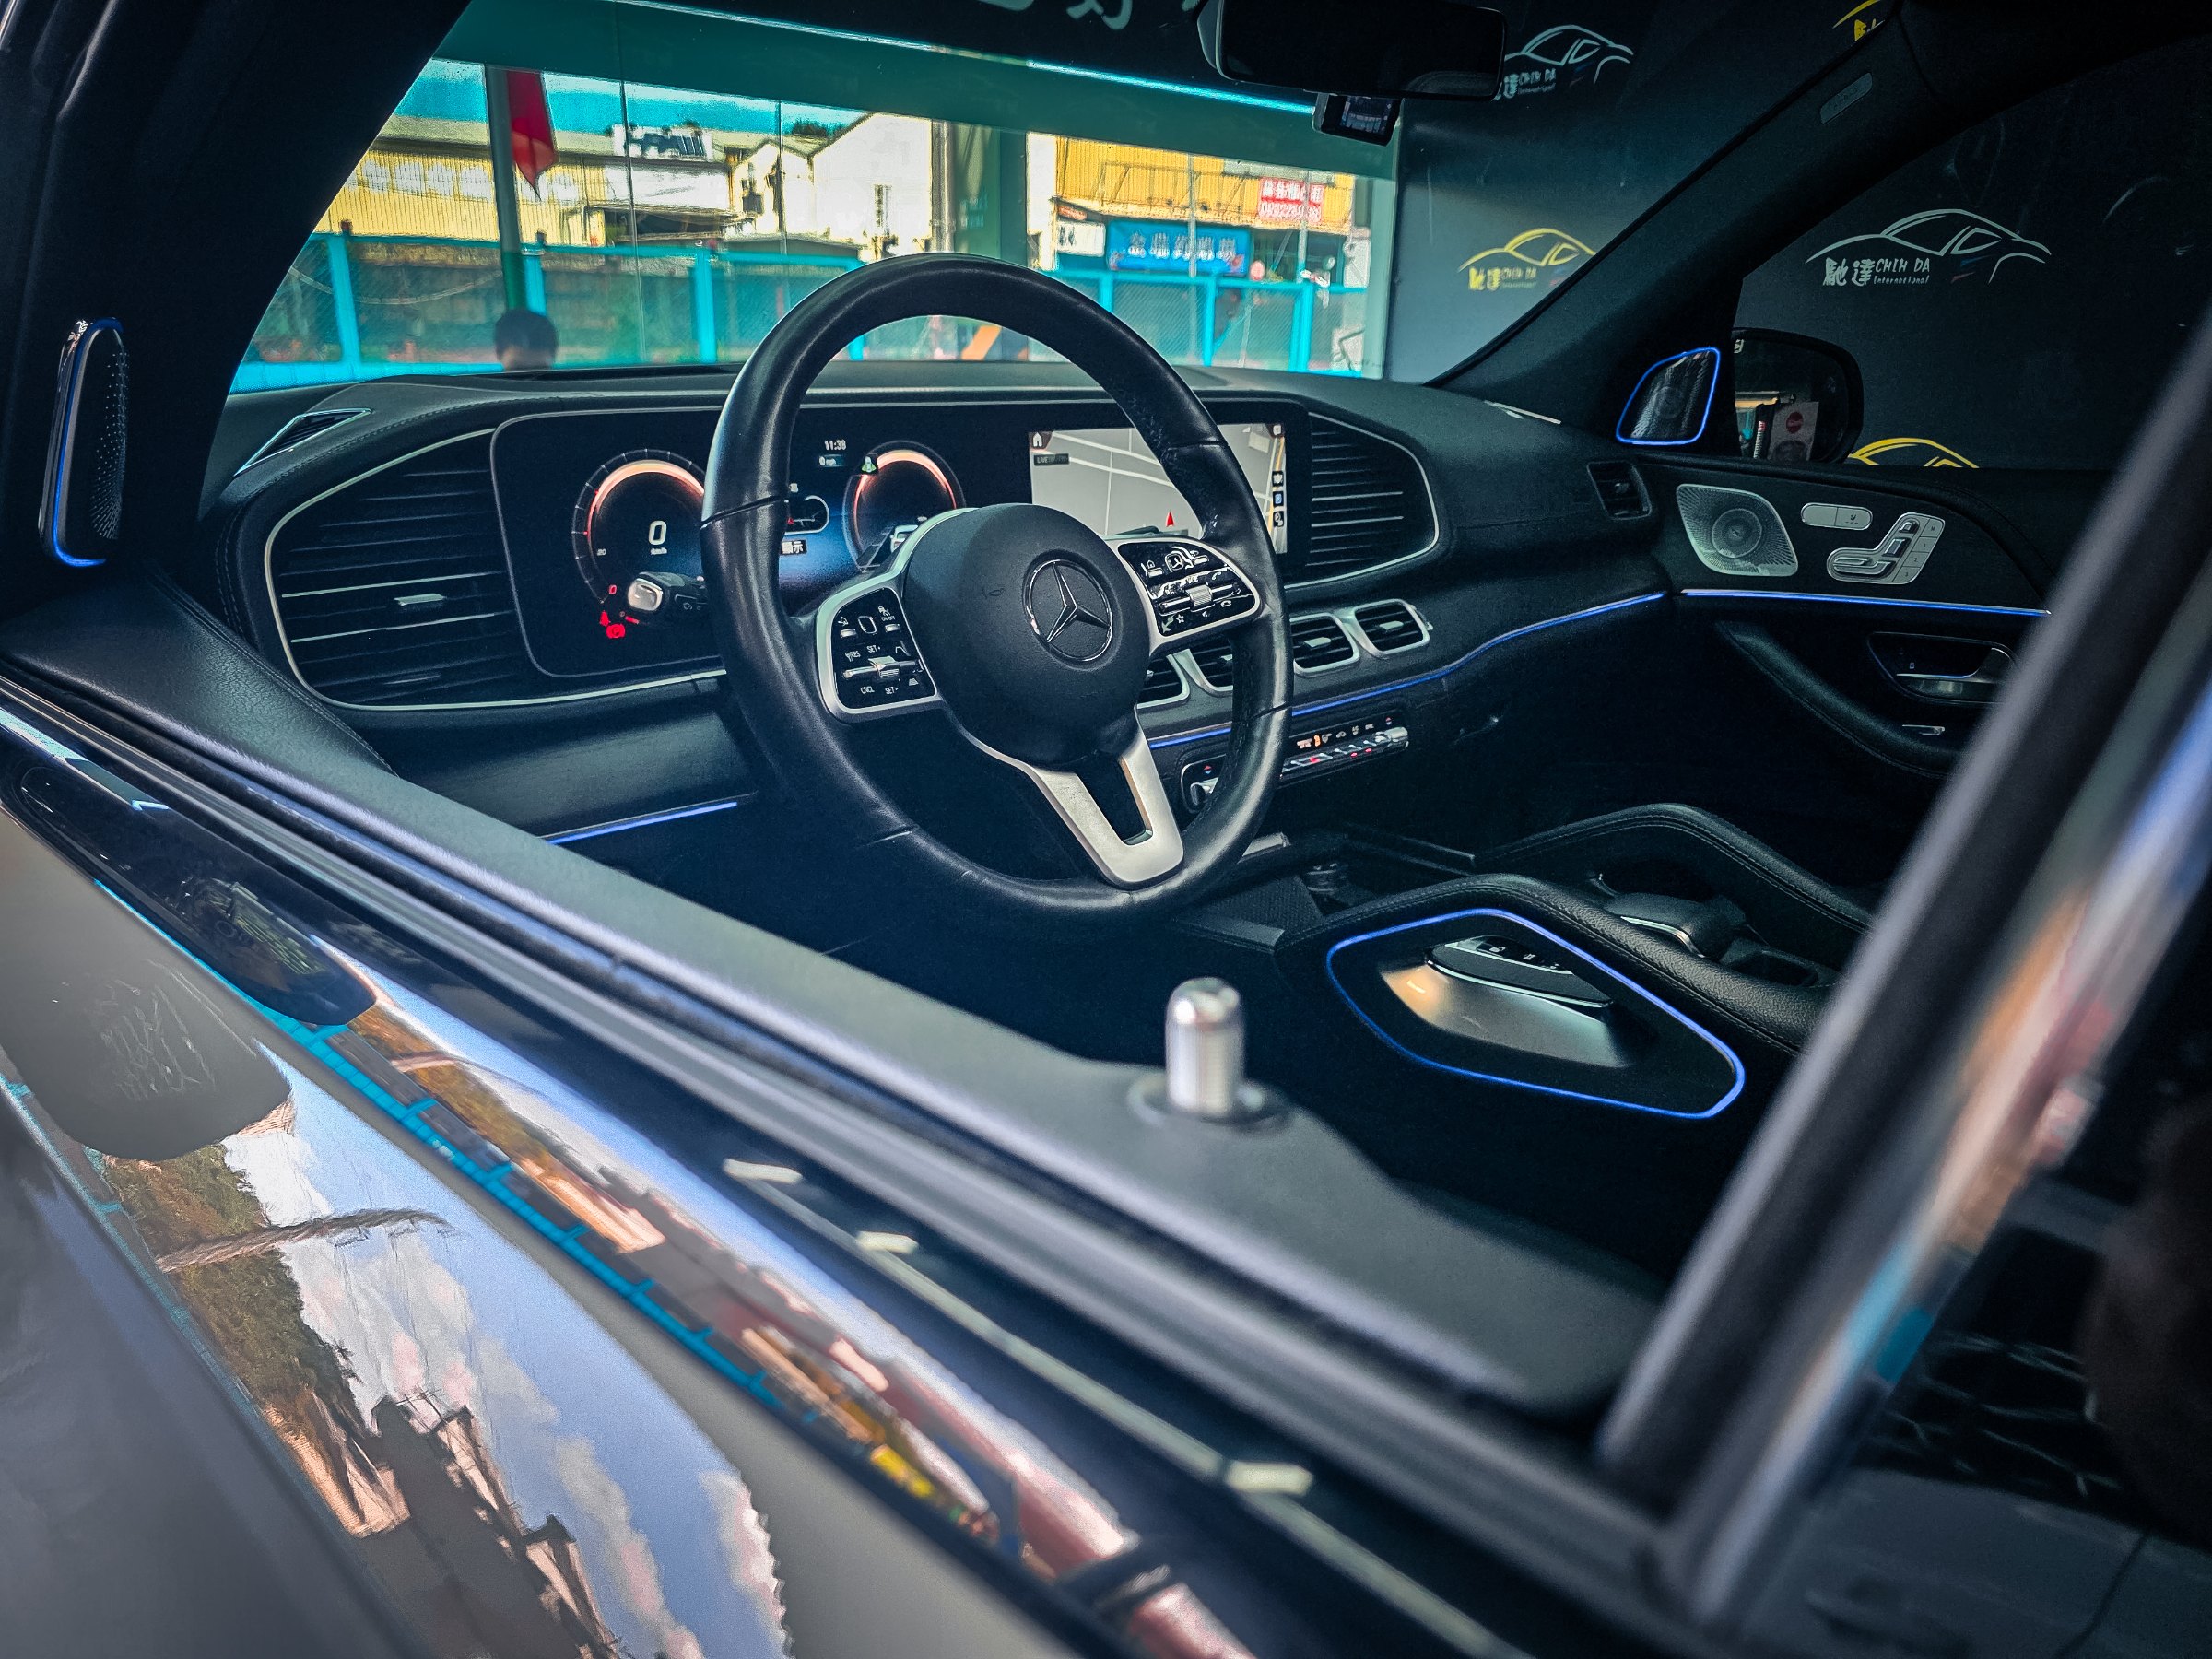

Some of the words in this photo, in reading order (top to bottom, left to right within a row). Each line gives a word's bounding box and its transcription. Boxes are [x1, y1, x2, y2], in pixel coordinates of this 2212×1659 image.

[1875, 257, 1909, 273] CHIH
[1913, 257, 1930, 273] DA
[1873, 275, 1930, 285] International
[648, 520, 667, 546] 0
